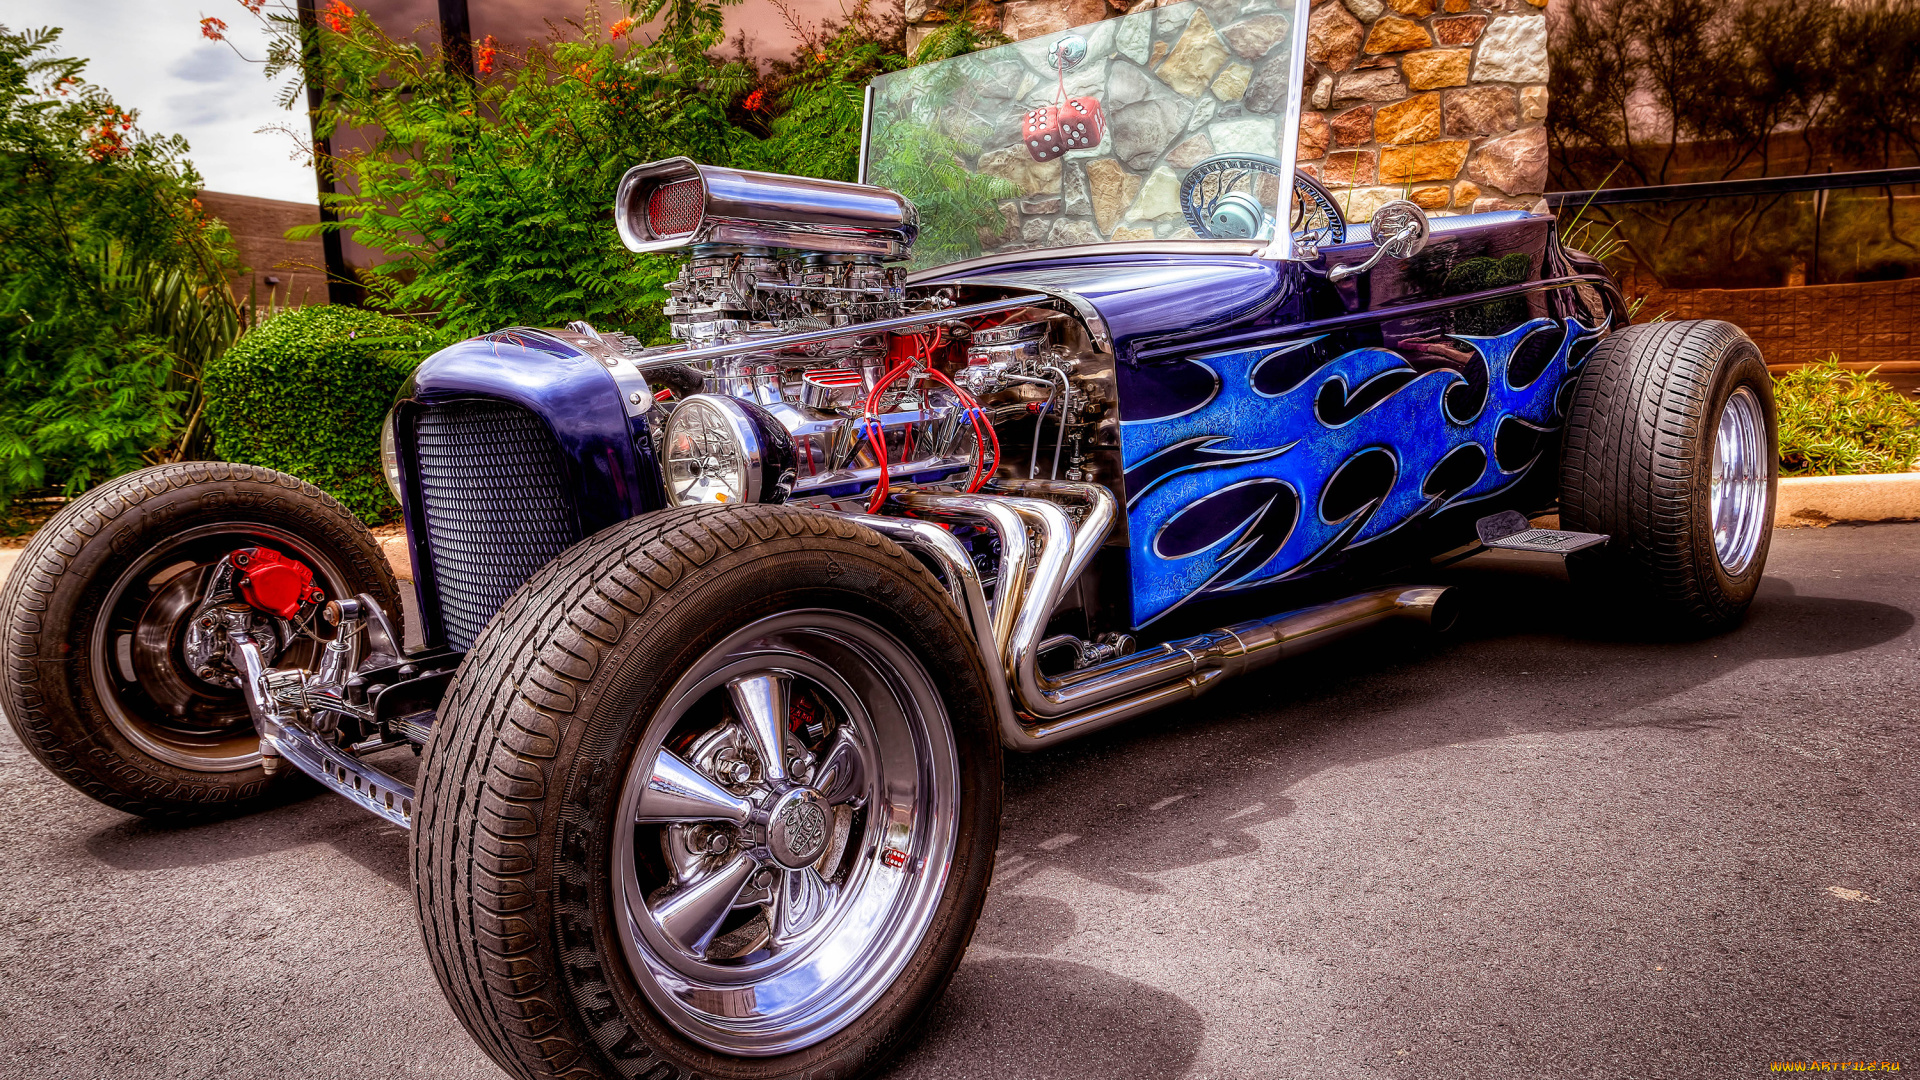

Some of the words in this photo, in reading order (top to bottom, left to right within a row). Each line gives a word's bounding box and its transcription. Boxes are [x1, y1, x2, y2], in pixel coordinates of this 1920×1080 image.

[201, 490, 387, 603] QUALIFIER
[591, 654, 620, 696] TREADWEAR
[633, 608, 660, 637] TRACTION
[670, 569, 712, 601] TEMPERATURE
[88, 747, 266, 803] DUNLOP
[551, 757, 703, 1080] UALIFIER
